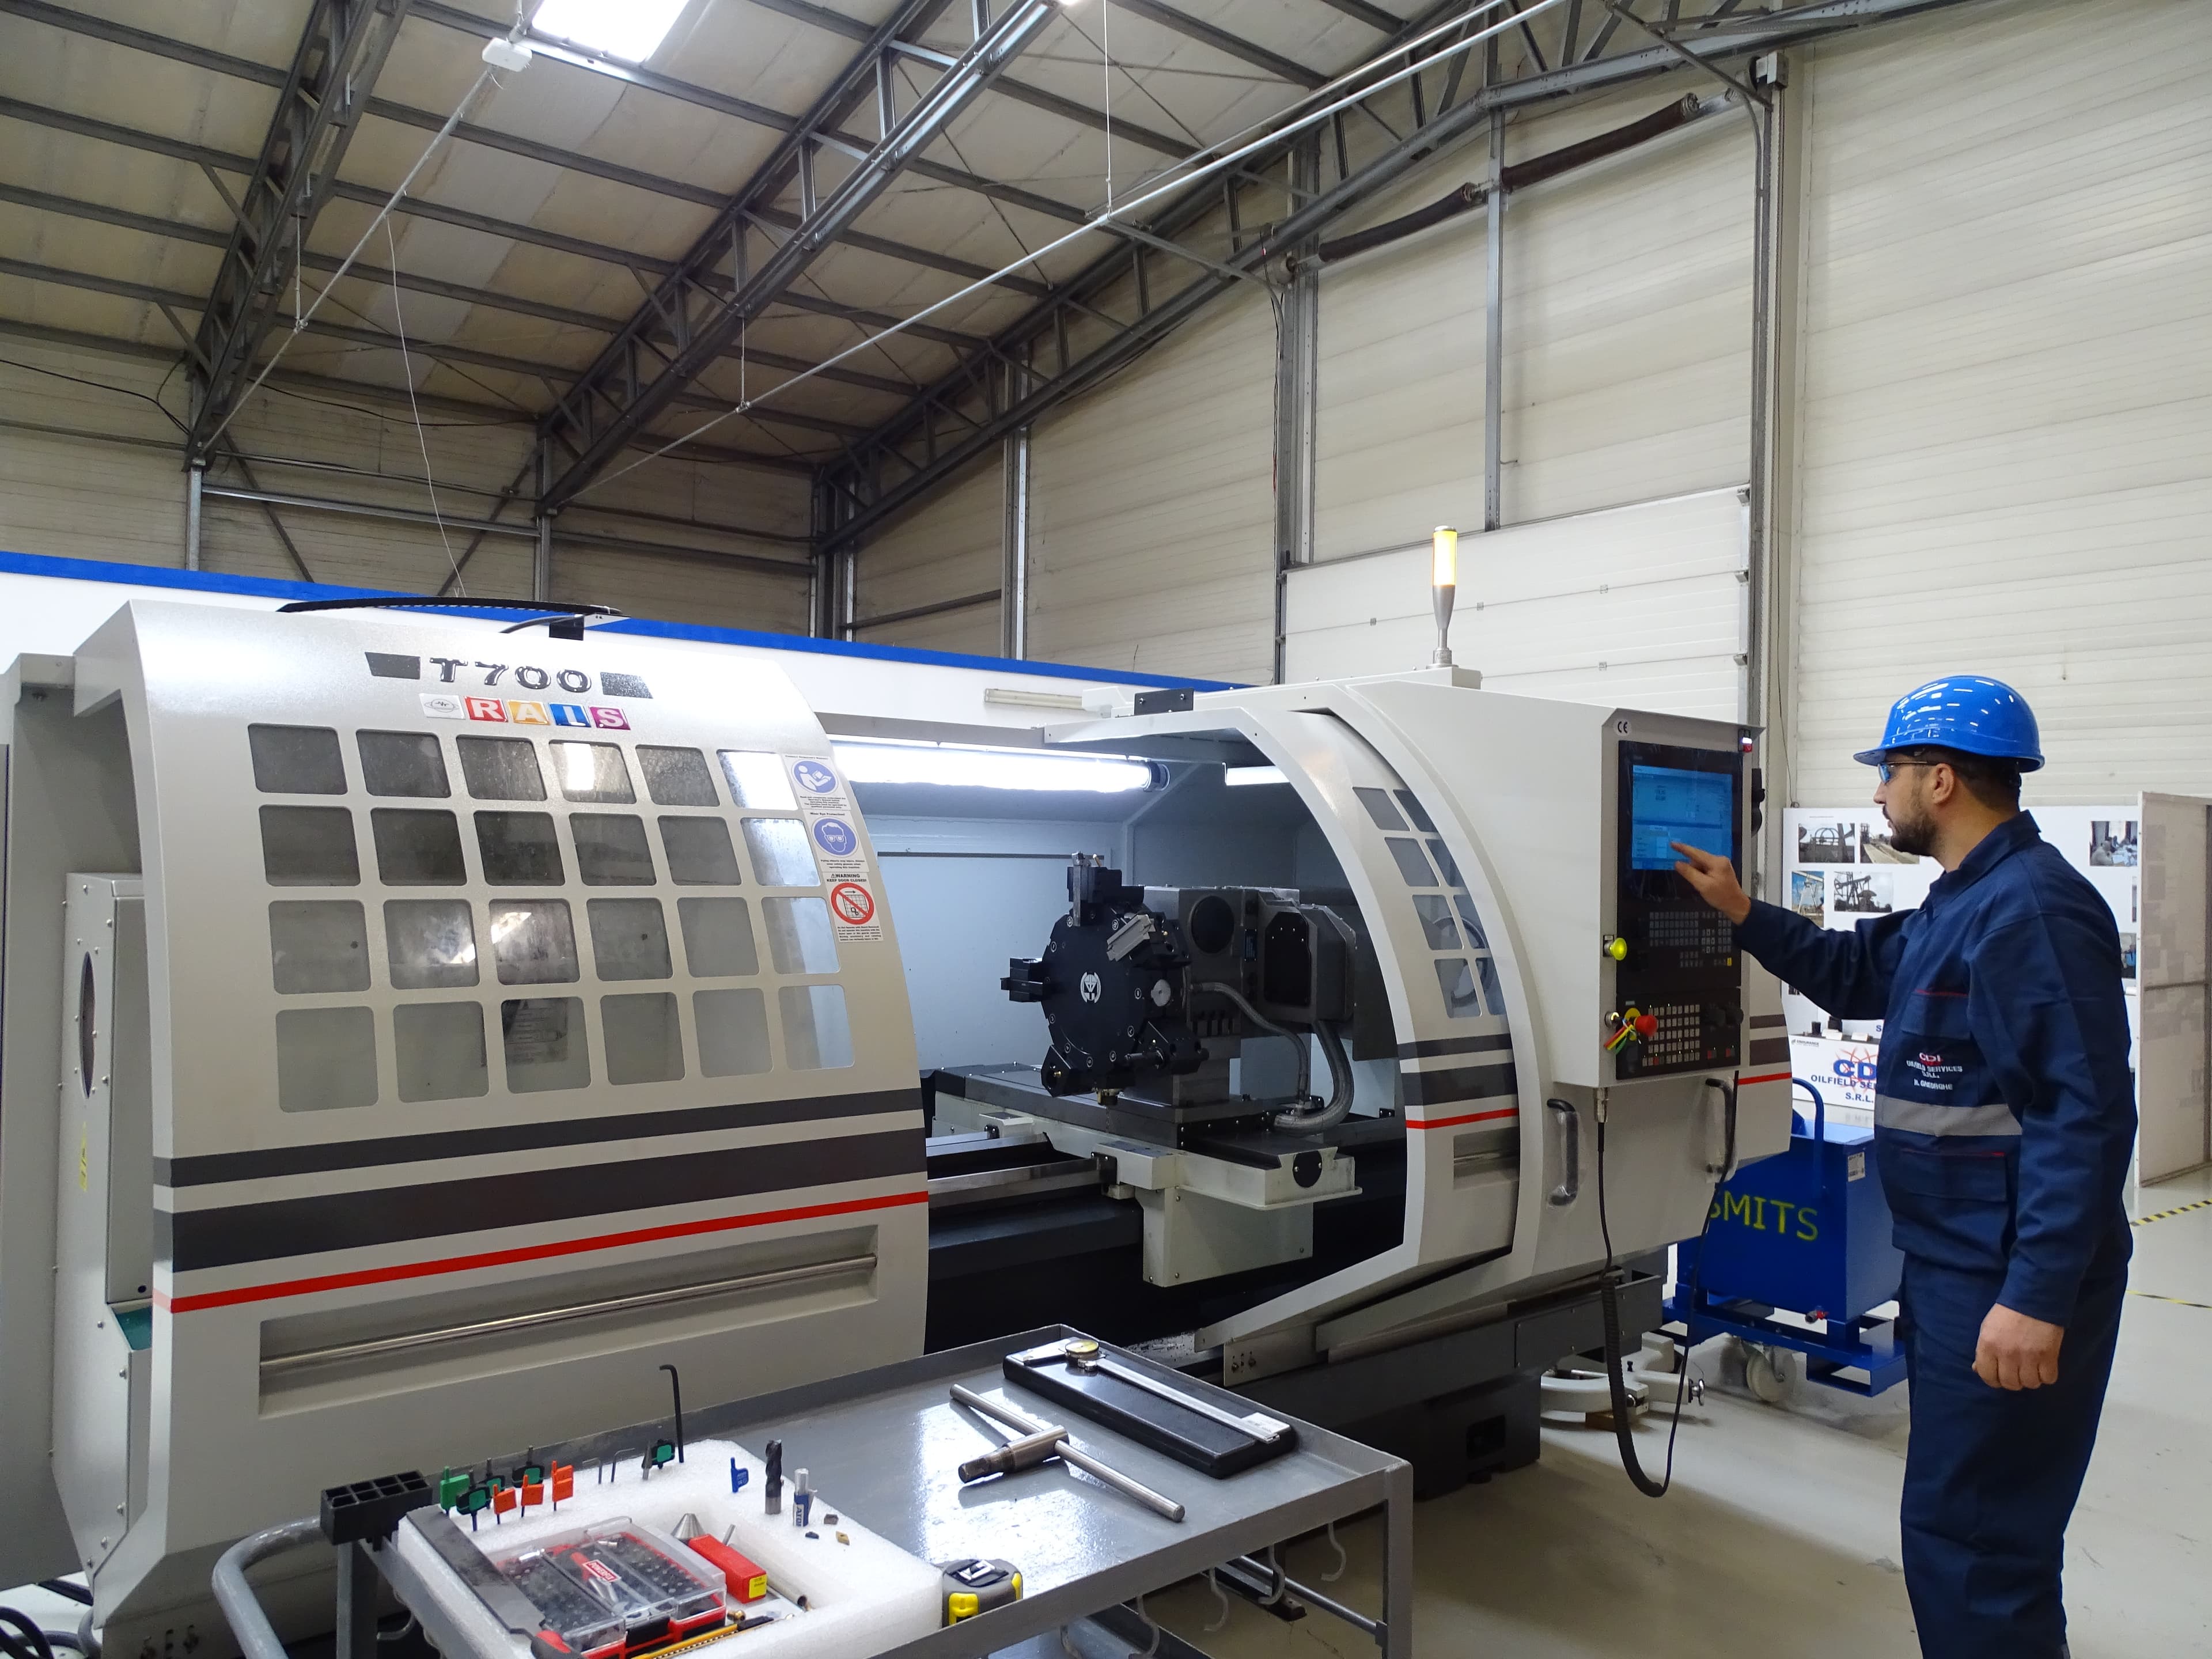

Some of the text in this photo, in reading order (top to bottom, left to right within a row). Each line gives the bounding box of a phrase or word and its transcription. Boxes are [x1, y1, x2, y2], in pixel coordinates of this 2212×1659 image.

[429, 657, 592, 694] T700
[1919, 1052, 1941, 1062] CDI
[1810, 1074, 1856, 1088] OILFIELD
[1845, 1092, 1874, 1103] S.R.L.
